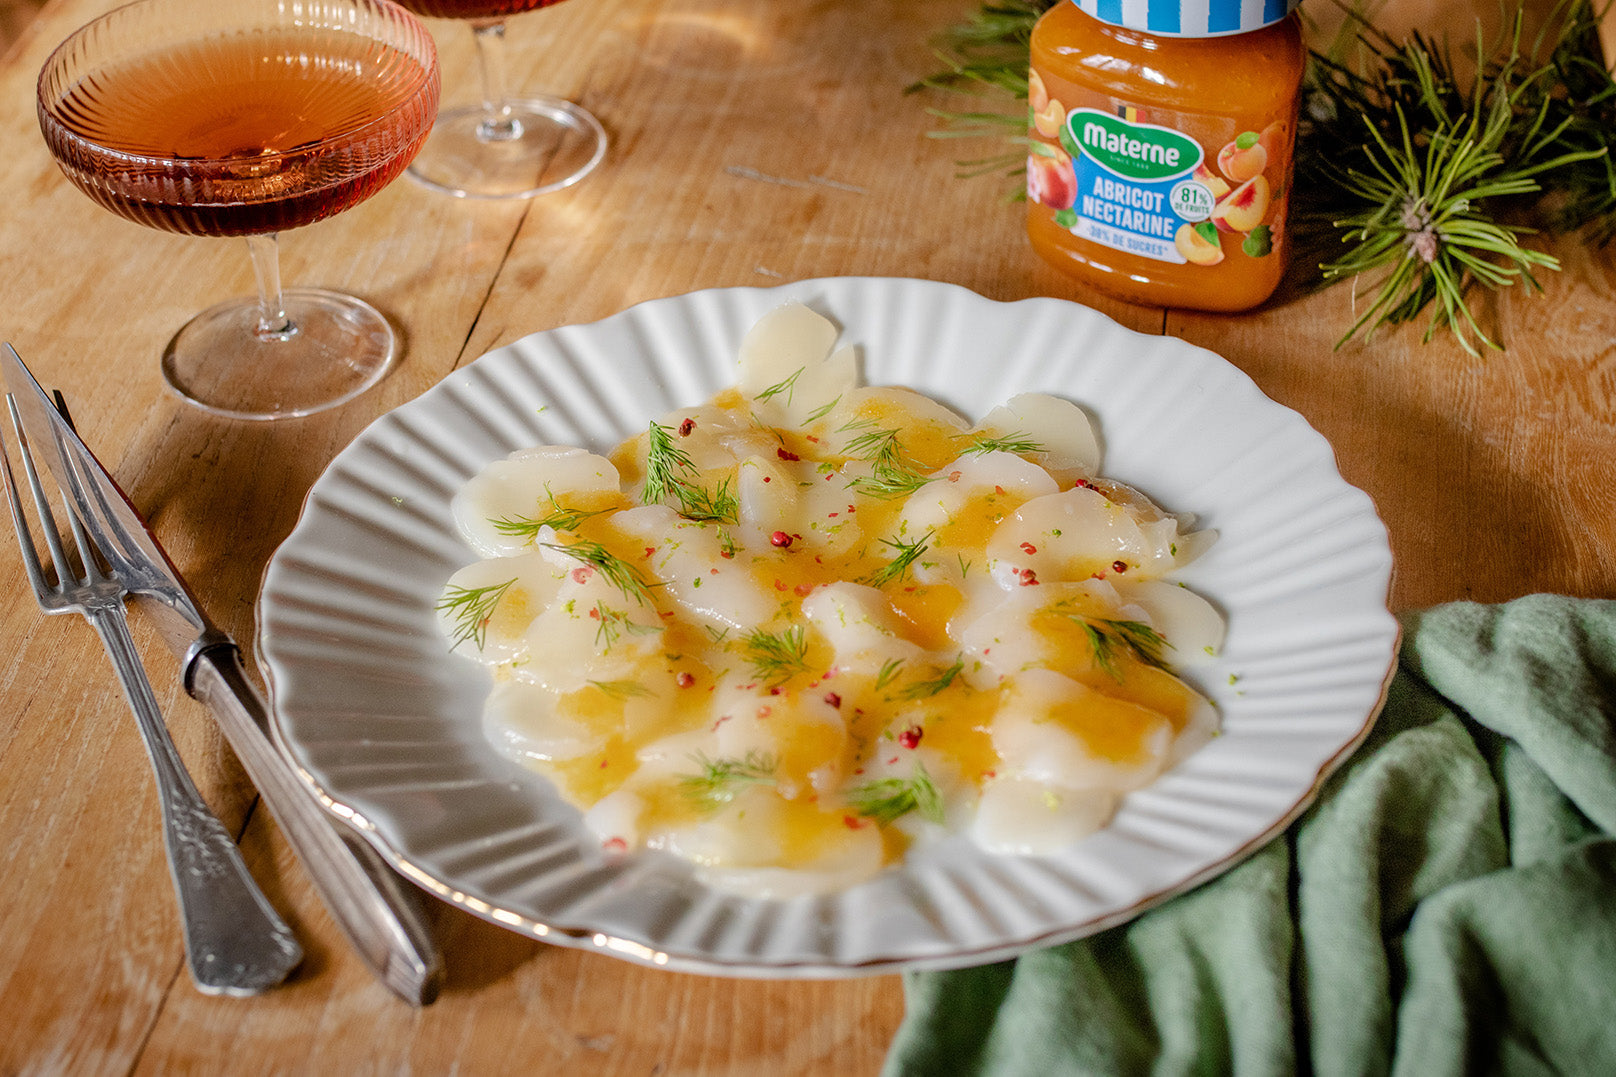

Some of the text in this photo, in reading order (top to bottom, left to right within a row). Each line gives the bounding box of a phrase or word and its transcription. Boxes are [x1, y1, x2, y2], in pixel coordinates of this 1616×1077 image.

[1084, 122, 1180, 167] Materne
[1093, 175, 1165, 214] ABRICOT
[1175, 202, 1210, 214] DE FRUITS
[1181, 187, 1208, 205] 81%
[1083, 194, 1174, 239] NECTARINE
[1112, 233, 1124, 247] DE
